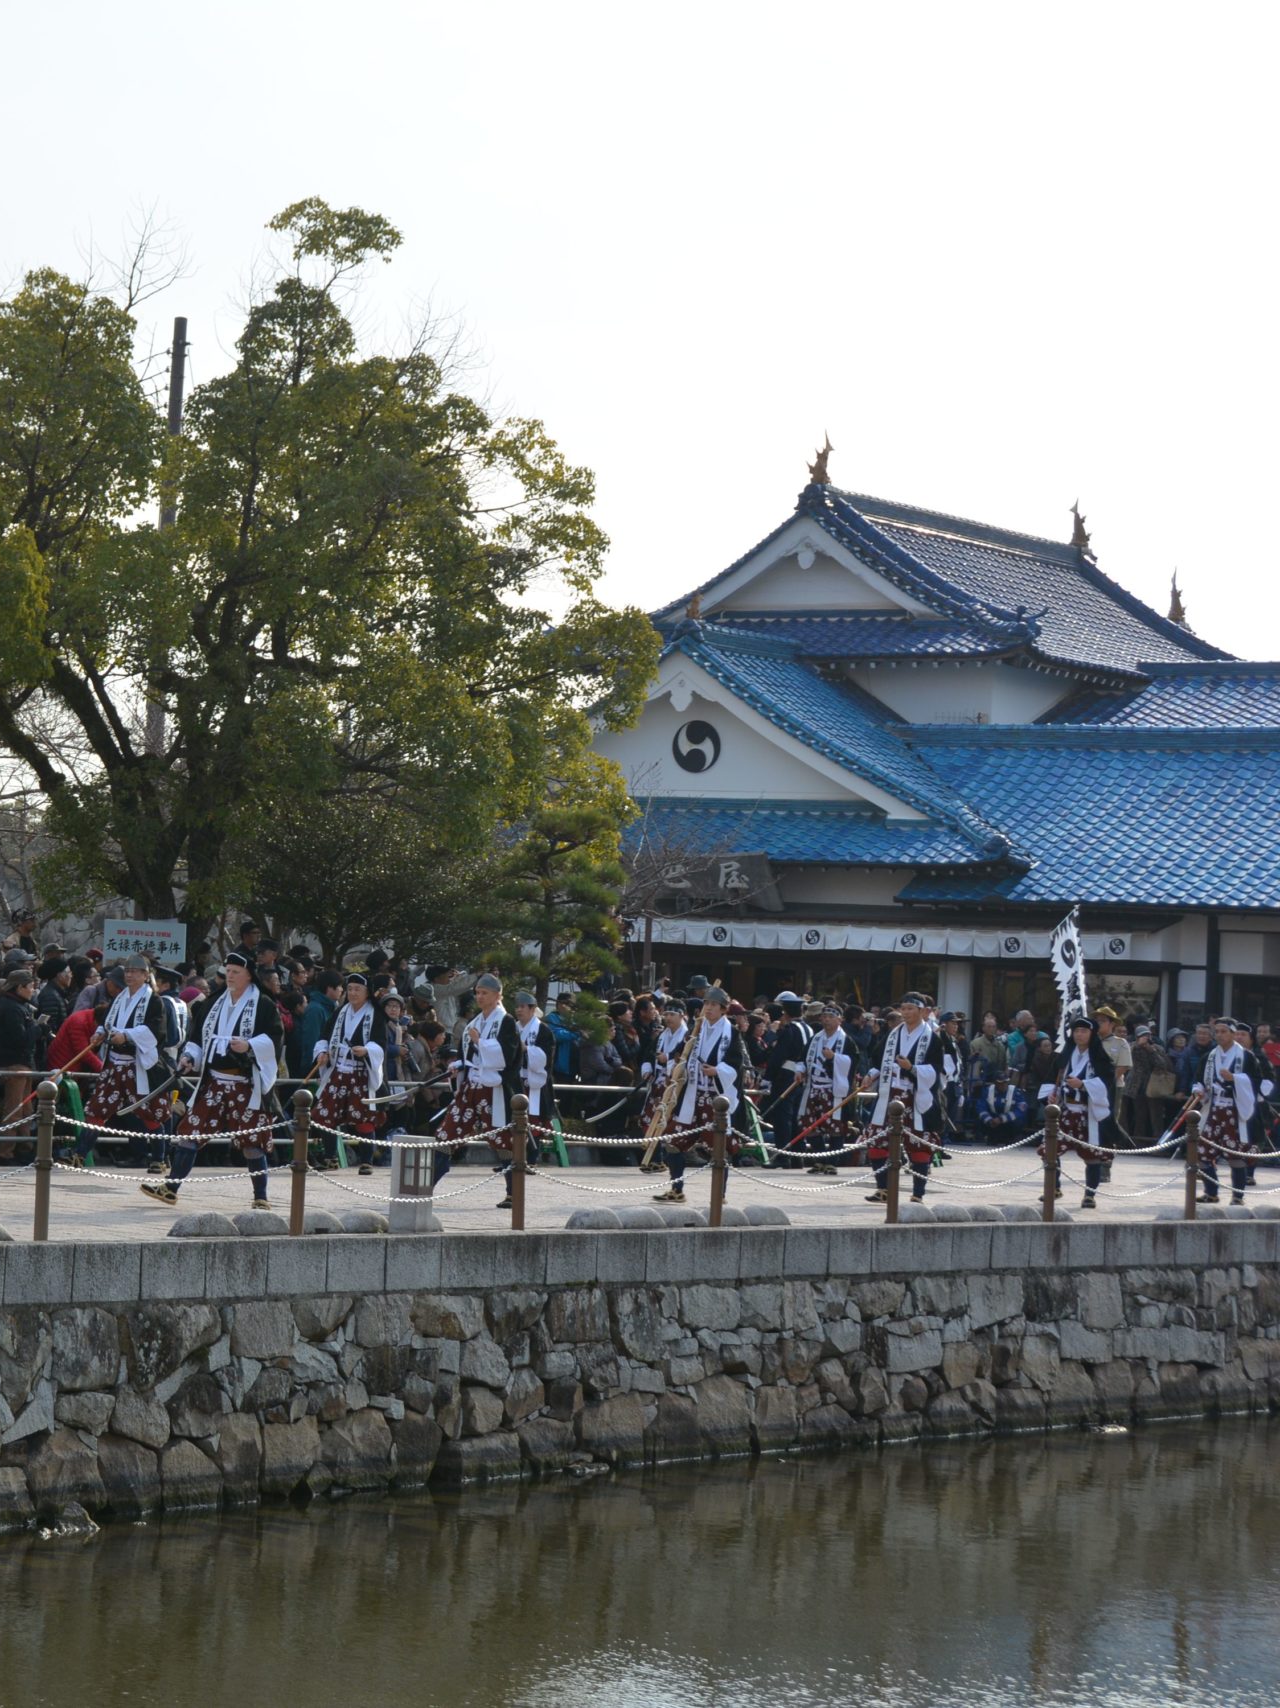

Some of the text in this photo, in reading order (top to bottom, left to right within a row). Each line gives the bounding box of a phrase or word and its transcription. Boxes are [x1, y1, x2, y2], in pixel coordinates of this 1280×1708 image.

[107, 938, 181, 955] 元禄赤穂事件
